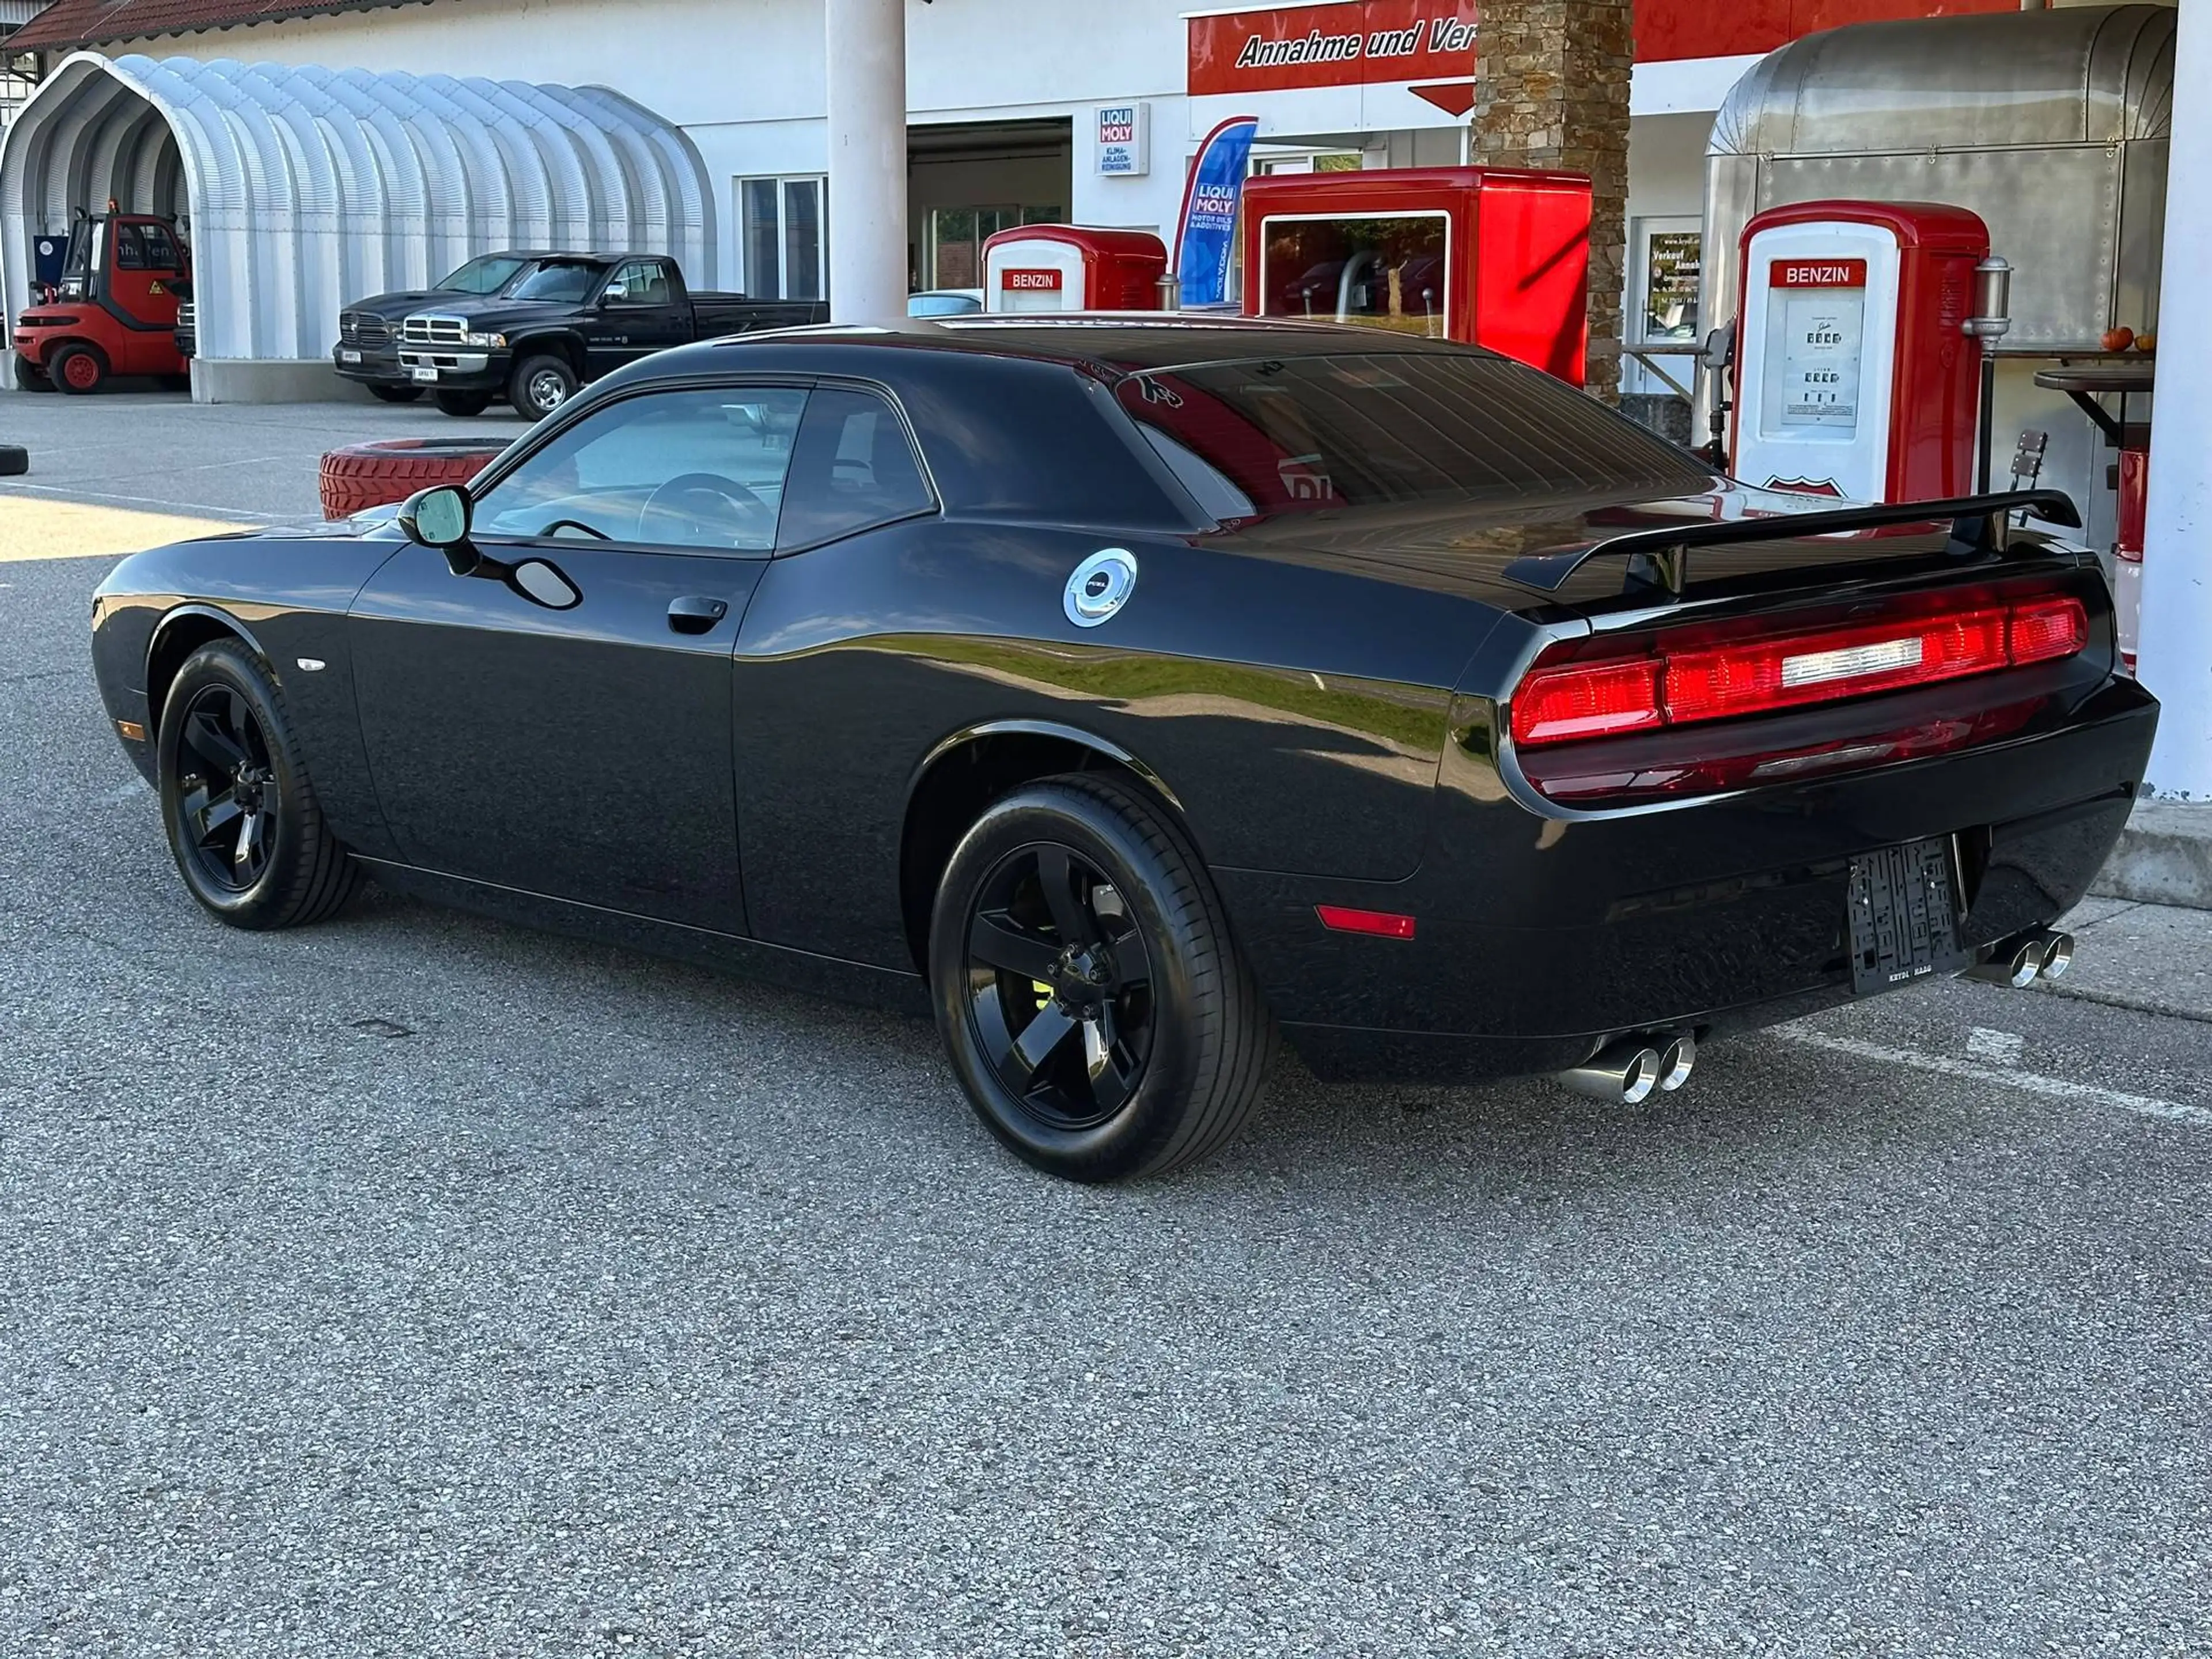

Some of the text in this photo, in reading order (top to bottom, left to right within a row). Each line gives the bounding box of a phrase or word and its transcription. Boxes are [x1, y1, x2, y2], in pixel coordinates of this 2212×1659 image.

[1235, 17, 1478, 68] Annahme und Ver
[1101, 109, 1131, 125] LIQUI
[1101, 126, 1132, 141] MOLY
[1199, 185, 1233, 199] LIQUI
[1196, 198, 1233, 213] MOLY
[1192, 214, 1215, 222] MOTOR
[1196, 222, 1230, 231] ADDITIVES
[1653, 249, 1684, 260] Verkauf
[1013, 274, 1053, 287] BENZIN
[1786, 267, 1849, 283] BENZIN
